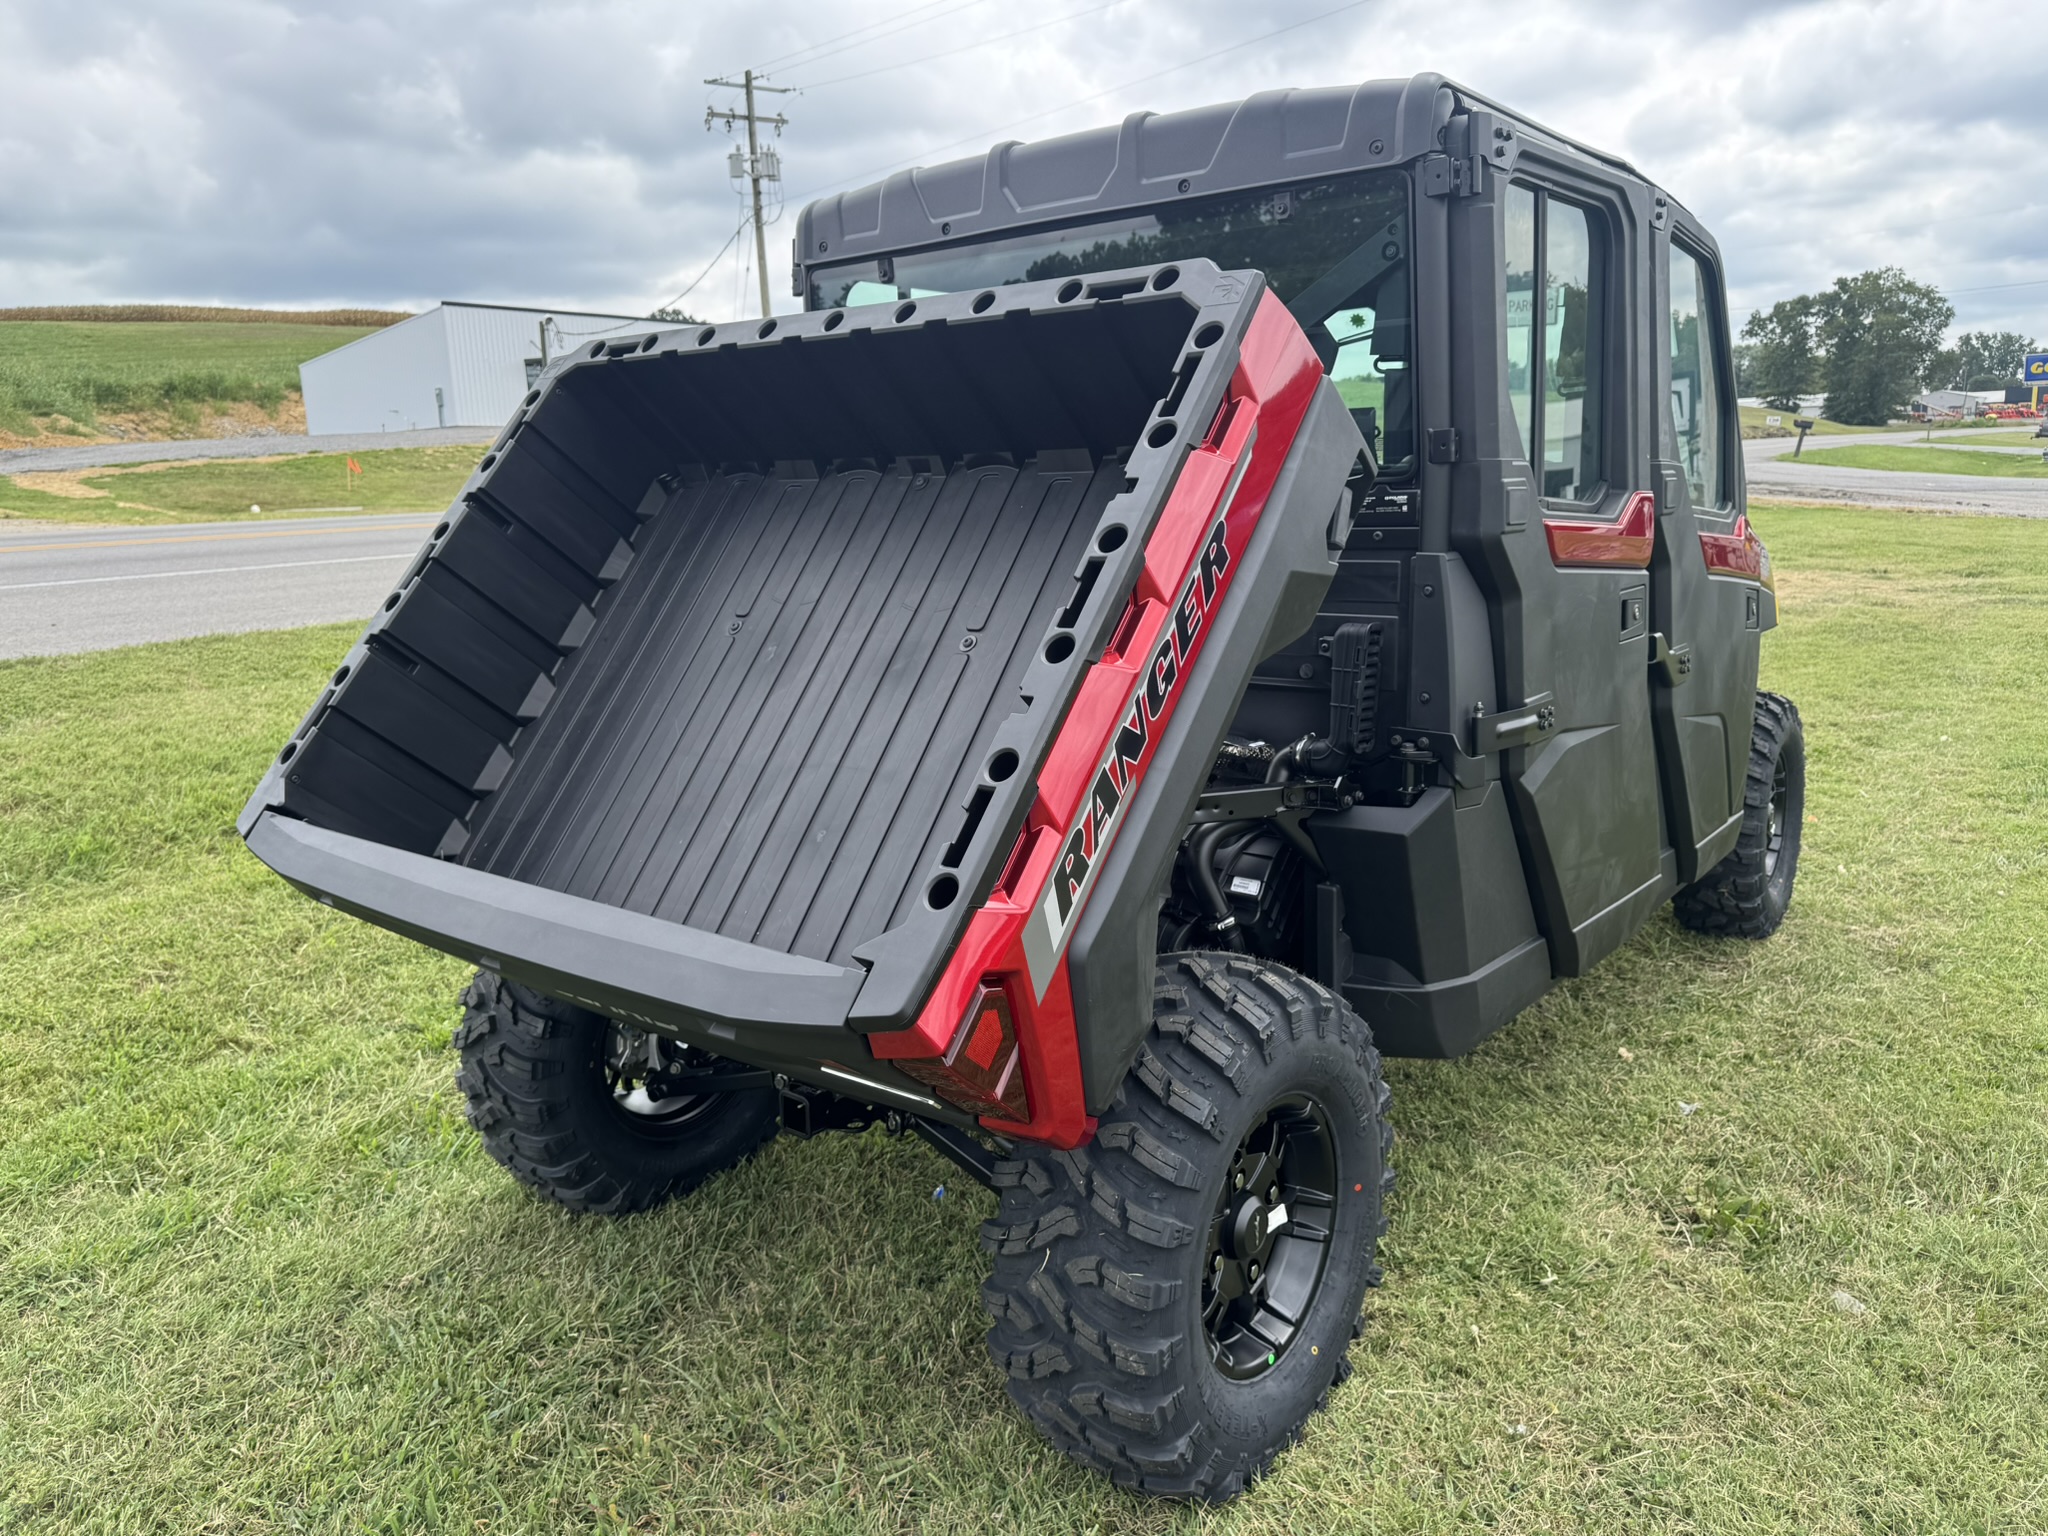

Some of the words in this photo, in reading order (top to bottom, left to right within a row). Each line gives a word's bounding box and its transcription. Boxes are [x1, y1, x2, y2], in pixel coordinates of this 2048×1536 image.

[1508, 298, 1554, 313] PARG
[2031, 362, 2048, 374] G
[1051, 518, 1230, 928] RANGER
